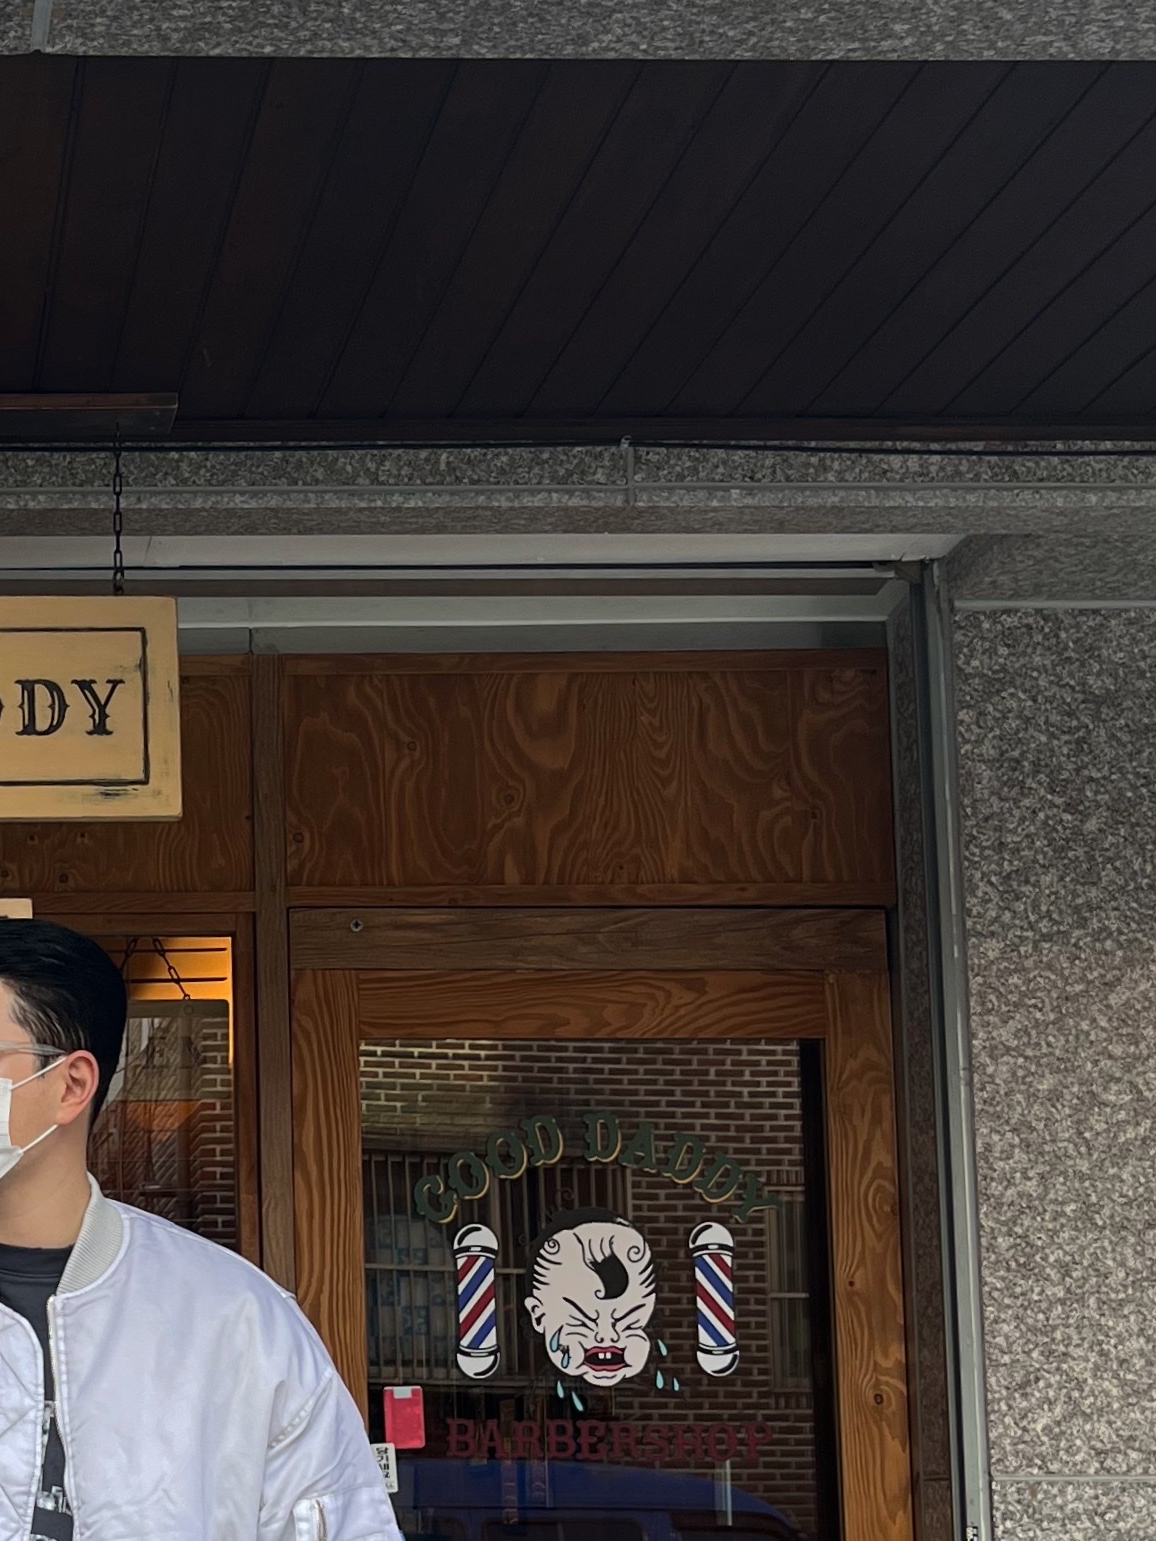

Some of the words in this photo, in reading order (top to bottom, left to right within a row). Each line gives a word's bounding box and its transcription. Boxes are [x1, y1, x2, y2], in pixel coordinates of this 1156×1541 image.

[413, 1114, 564, 1224] GOOD
[583, 1112, 782, 1225] DADDY
[446, 1417, 775, 1463] BARBERSHOP
